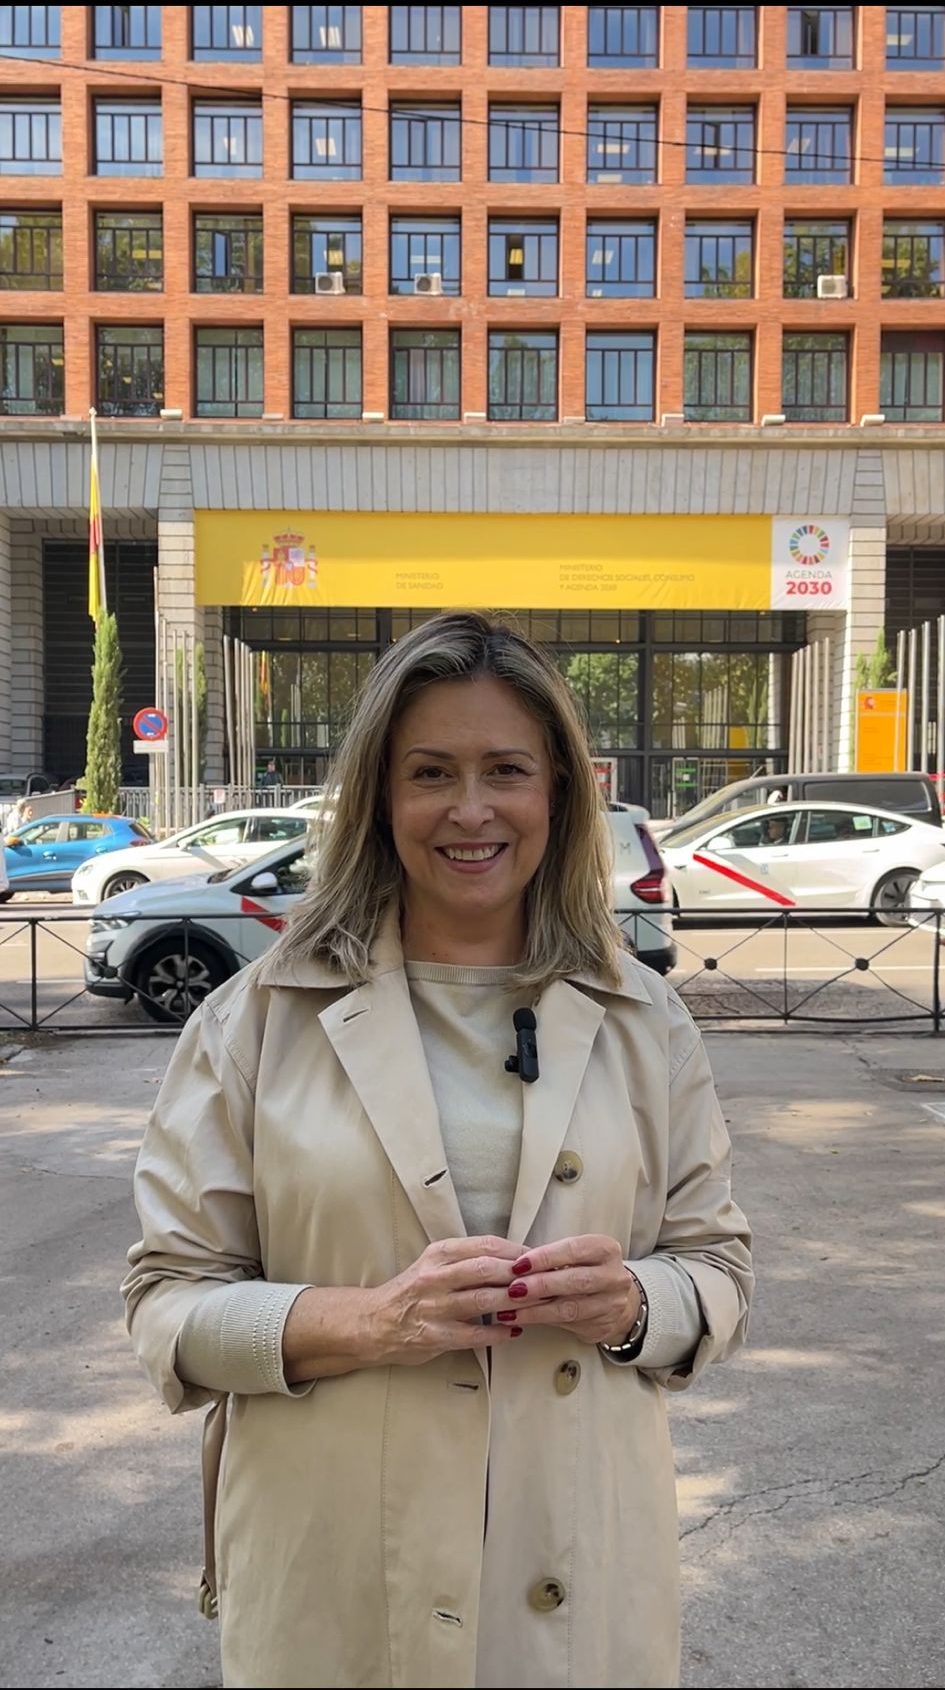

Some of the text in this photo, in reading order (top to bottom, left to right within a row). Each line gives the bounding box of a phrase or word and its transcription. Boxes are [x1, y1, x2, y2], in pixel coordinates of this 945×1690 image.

[395, 572, 440, 580] MINISTERIO
[785, 570, 832, 579] AGENDA
[408, 582, 444, 590] SANIDAD
[786, 581, 832, 595] 2030
